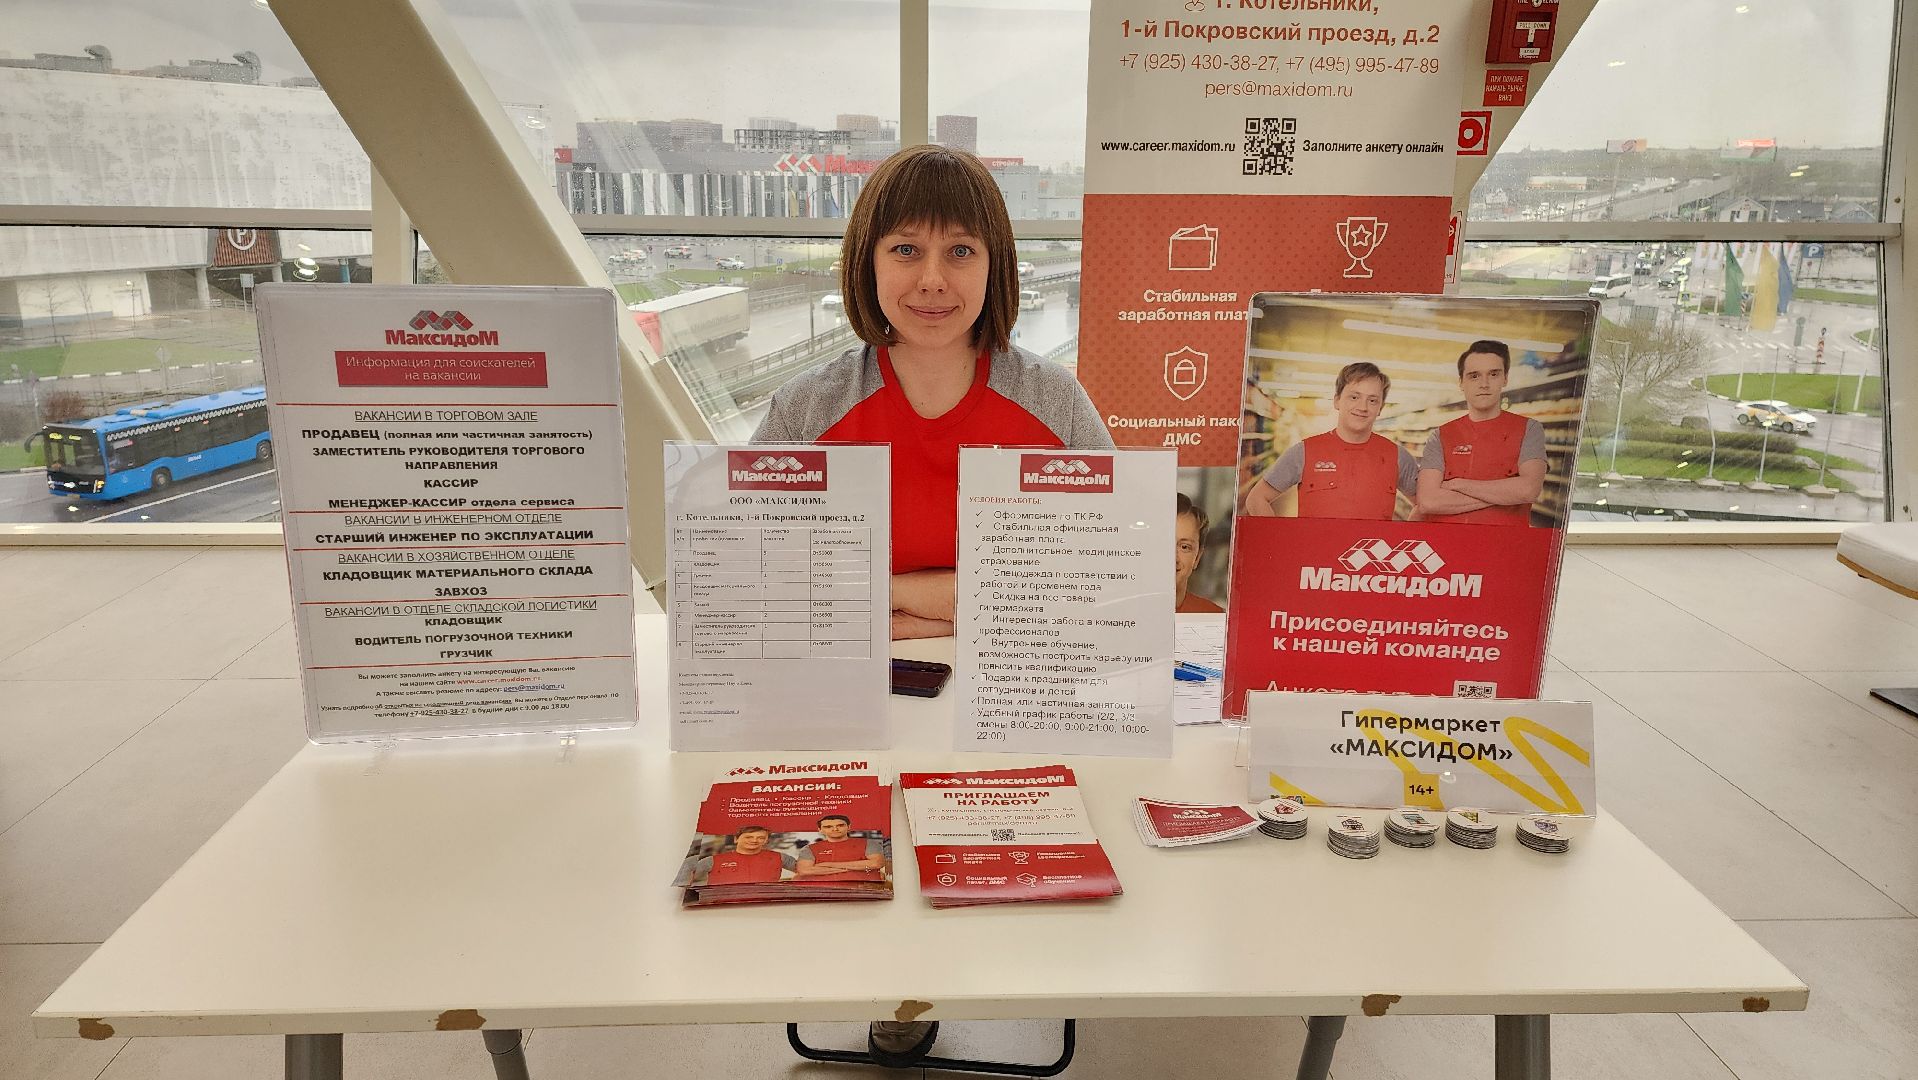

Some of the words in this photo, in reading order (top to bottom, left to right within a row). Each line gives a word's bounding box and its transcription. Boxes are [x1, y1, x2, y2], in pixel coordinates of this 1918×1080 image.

[1121, 20, 1157, 38] 1-й
[1164, 21, 1301, 43] Покровский
[1308, 26, 1396, 46] проезд,
[1404, 26, 1440, 46] д.2
[1120, 55, 1139, 69] +7
[1143, 53, 1186, 72] (925)
[1191, 55, 1281, 74] 430-38-27,
[1285, 57, 1305, 71] +7
[1309, 55, 1351, 75] (495)
[1356, 57, 1439, 74] 995-47-89
[1205, 81, 1353, 99] pers@maxidom.ru
[1101, 138, 1236, 154] www.career.maxidom.ru
[1302, 140, 1363, 154] Заполните
[1366, 143, 1404, 156] анкету
[1406, 141, 1444, 155] онлайн
[1143, 288, 1237, 304] Стабильная
[1118, 308, 1211, 324] заработная
[1214, 310, 1250, 322] плат
[345, 357, 431, 369] Информация
[434, 358, 455, 369] для
[459, 357, 536, 368] соискателей
[405, 372, 419, 380] на
[423, 371, 481, 381] вакансии
[355, 410, 422, 421] ВАКАНСИИ
[425, 411, 432, 421] В
[435, 410, 504, 421] ТОРГОВОМ
[507, 411, 538, 421] ЗАЛЕ
[1108, 413, 1206, 430] Социальный
[1210, 416, 1241, 428] пак
[302, 429, 380, 441] ПРОДАВЕЦ
[383, 430, 432, 440] (полная
[462, 431, 526, 439] частичная
[529, 430, 593, 440] занятость)
[1163, 432, 1202, 447] ДМС
[312, 447, 406, 456] ЗАМЕСТИТЕЛЬ
[409, 446, 508, 457] РУКОВОДИТЕЛЯ
[512, 446, 585, 455] ТОРГОВОГО
[405, 461, 498, 470] НАПРАВЛЕНИЯ
[423, 479, 479, 488] КАССИР
[328, 498, 467, 509] МЕНЕДЖЕР-КАССИР
[471, 498, 517, 508] отдела
[520, 498, 575, 508] сервиса
[730, 497, 753, 505] ООО
[755, 497, 827, 506] «МАКСИДОМ»
[344, 514, 411, 526] ВАКАНСИИ
[423, 514, 512, 524] ИНЖЕНЕРНОМ
[515, 513, 562, 523] ОТДЕЛЕ
[686, 514, 744, 523] Котельники,
[746, 513, 760, 521] 1-й
[762, 513, 816, 523] Покровский
[819, 515, 851, 523] проезд,
[853, 514, 865, 522] д.2
[315, 532, 383, 544] СТАРШИЙ
[388, 532, 458, 542] ИНЖЕНЕР
[462, 532, 480, 541] ПО
[484, 530, 594, 541] ЭКСПЛУАТАЦИИ
[338, 552, 404, 563] ВАКАНСИИ
[407, 552, 415, 561] В
[418, 549, 526, 562] ХОЗЯЙСТВЕННОМ
[528, 549, 575, 559] ОТДЕЛЕ
[322, 569, 412, 582] КЛАДОВЩИК
[416, 567, 535, 578] МАТЕРИАЛЬНОГО
[539, 565, 593, 577] СКЛАДА
[435, 587, 488, 597] ЗАВХОЗ
[325, 606, 389, 618] ВАКАНСИИ
[403, 603, 452, 615] ОТДЕЛЕ
[454, 601, 526, 613] СКЛАДСКОЙ
[528, 600, 598, 610] ЛОГИСТИКИ
[425, 617, 502, 627] КЛАДОВЩИК
[1270, 610, 1510, 640] Присоединяйтесь
[355, 635, 422, 646] ВОДИТЕЛЬ
[425, 631, 514, 643] ПОГРУЗОЧНОЙ
[518, 630, 572, 640] ТЕХНИКИ
[440, 649, 493, 659] ГРУЗЧИК
[1273, 636, 1286, 651] к
[1292, 637, 1378, 656] нашей
[1384, 640, 1501, 662] команде
[1341, 710, 1501, 733] Гипермаркет
[1330, 737, 1514, 763] «МАКСИДОМ»
[752, 783, 841, 793] ВАКАНСИИ:
[943, 791, 1050, 799] ПРИГЛАШАЕМ
[1409, 784, 1435, 796] 14+
